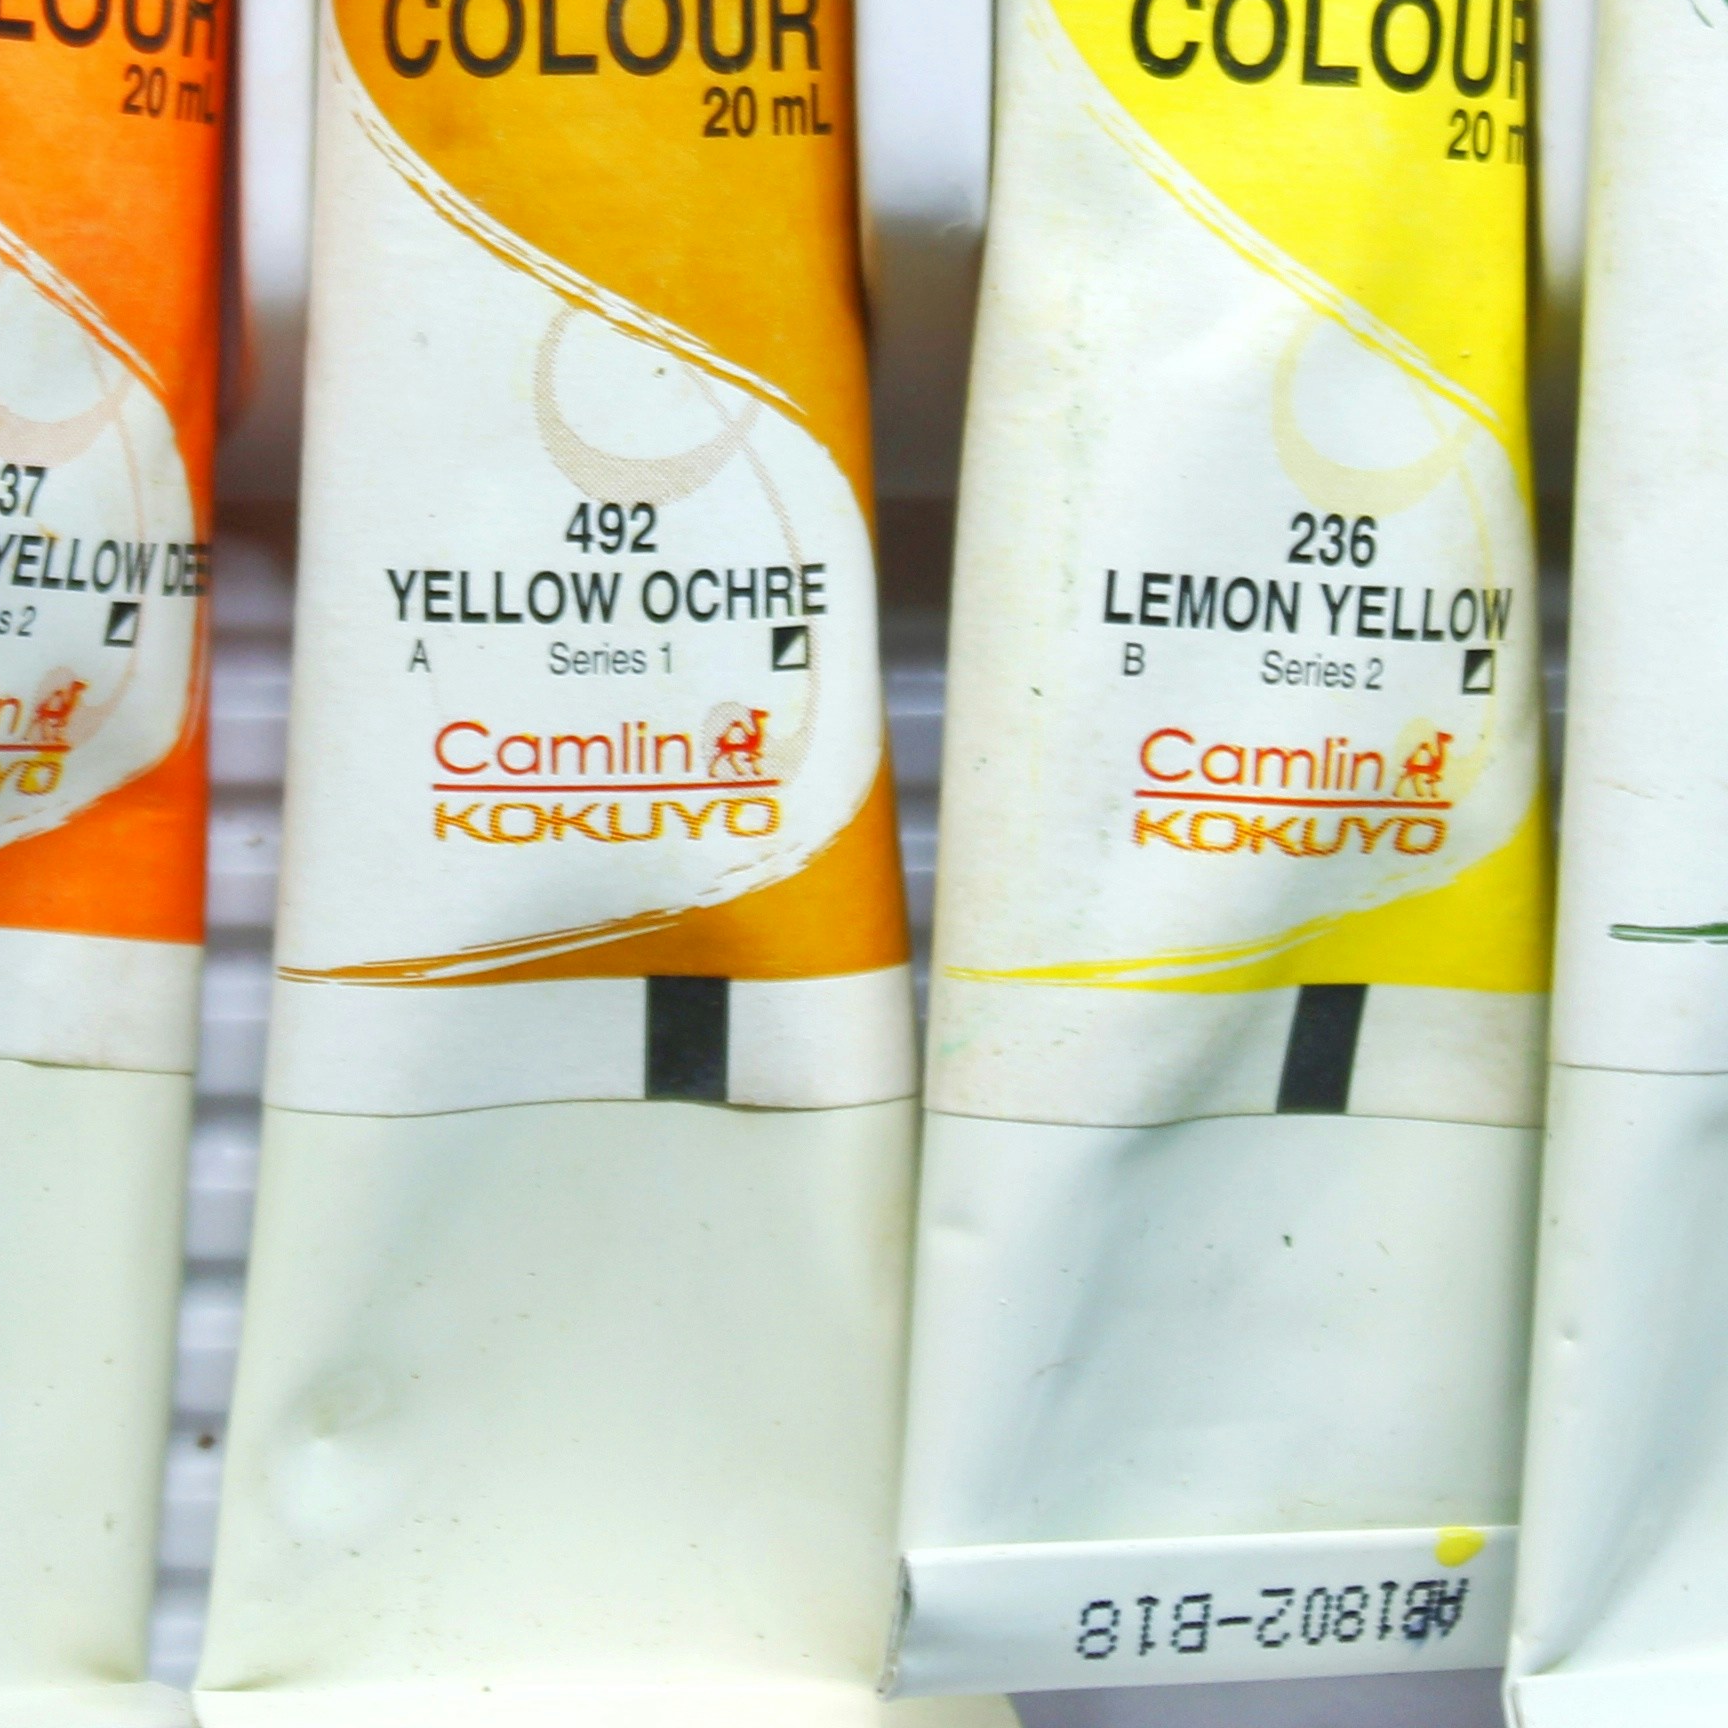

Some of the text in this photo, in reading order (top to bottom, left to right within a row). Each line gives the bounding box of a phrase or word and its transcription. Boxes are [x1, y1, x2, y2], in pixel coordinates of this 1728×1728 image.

[122, 63, 218, 126] 20 mL
[702, 84, 833, 139] 20 mL
[1446, 107, 1494, 161] 20
[565, 502, 658, 555] 492
[1287, 511, 1379, 569] 236
[385, 563, 829, 625] YELLOW OCHRE
[1103, 569, 1513, 643] LEMON YELLOW
[17, 605, 37, 638] 2
[407, 640, 674, 676] A Series 1
[1122, 642, 1385, 691] B Series 2
[434, 720, 693, 776] Camlin
[1139, 727, 1386, 792] Camlin
[432, 795, 781, 845] KOKUYO
[1132, 810, 1450, 857] KOKUYO
